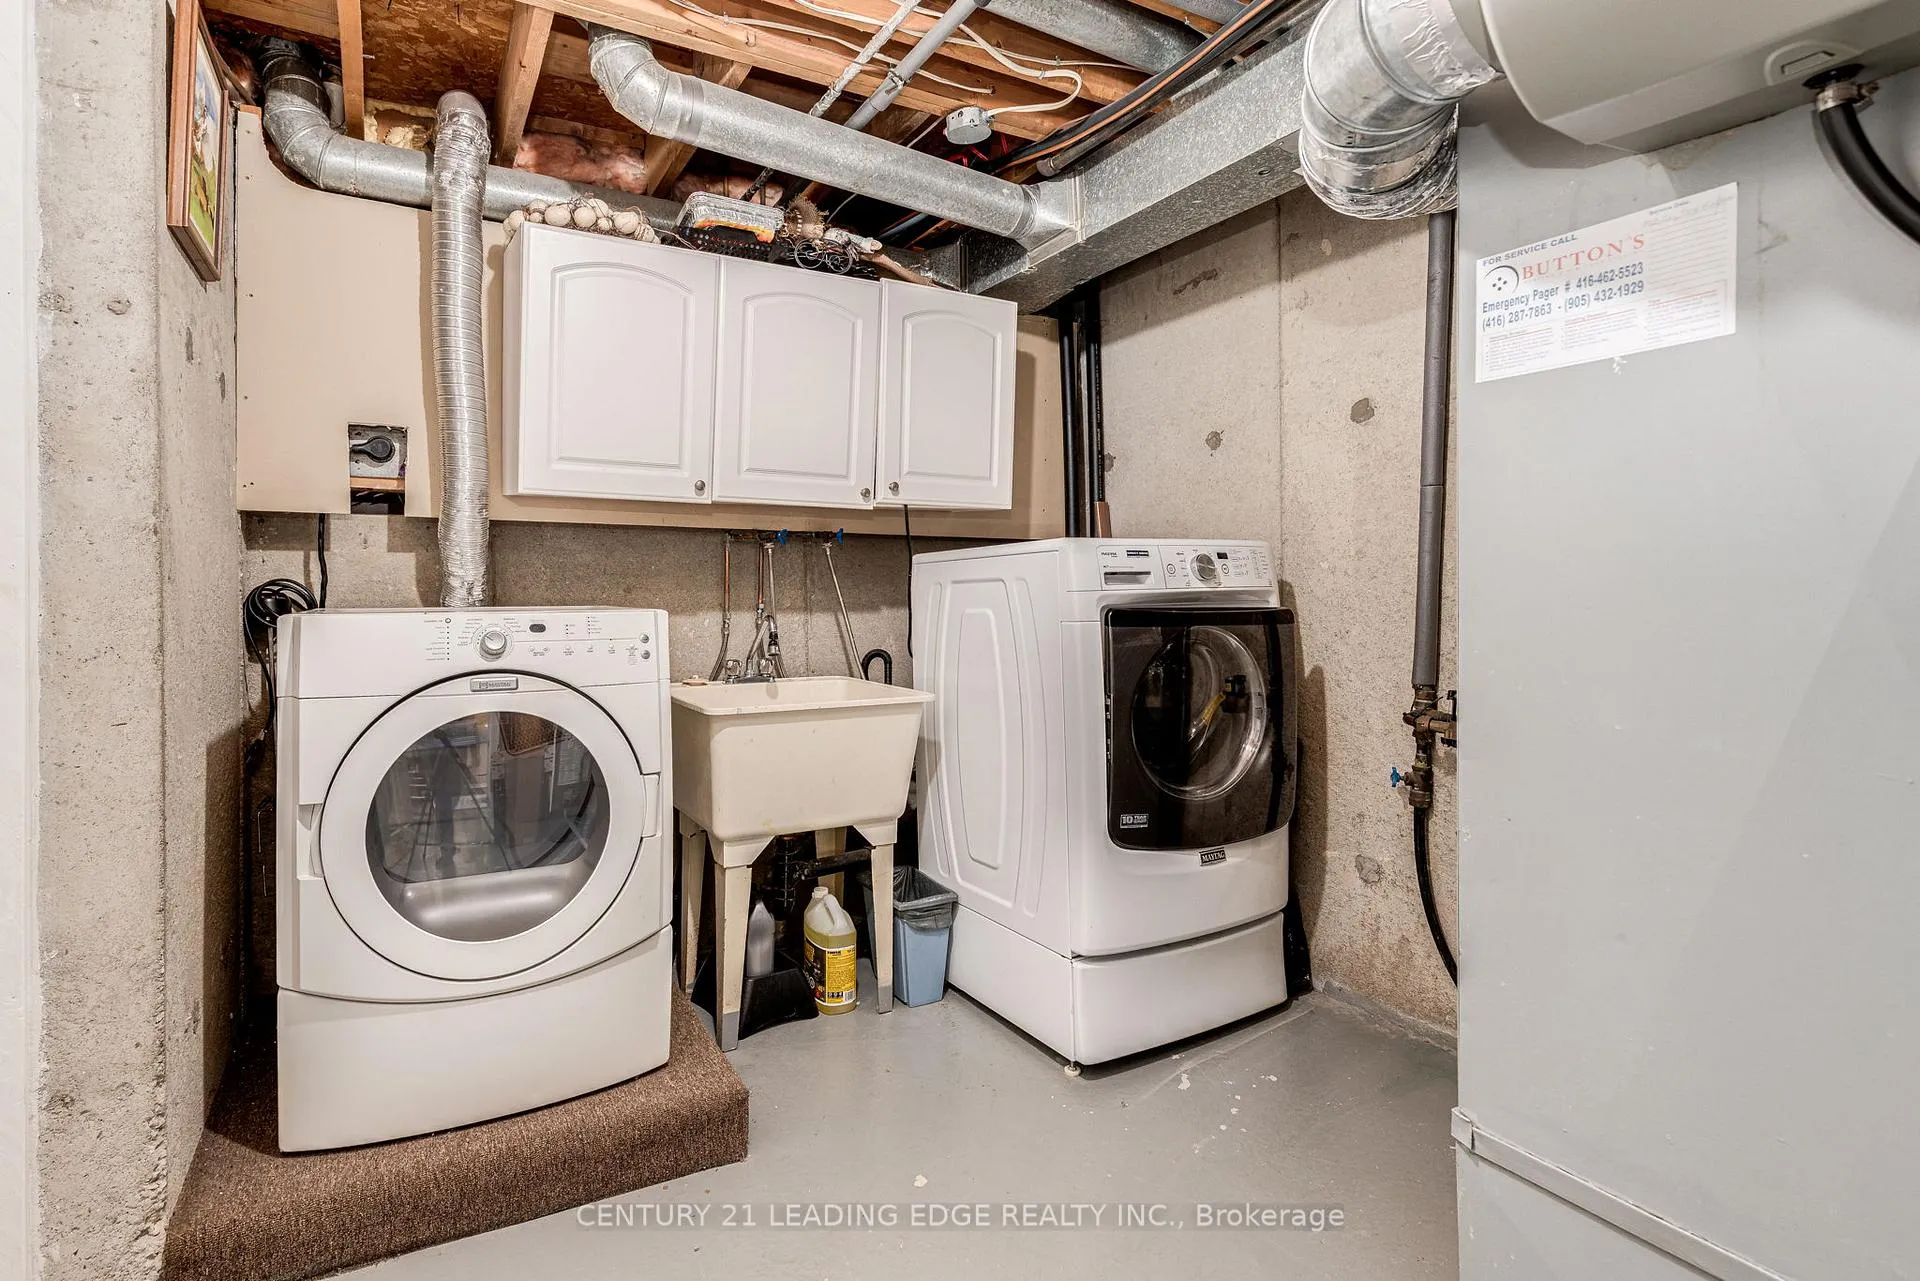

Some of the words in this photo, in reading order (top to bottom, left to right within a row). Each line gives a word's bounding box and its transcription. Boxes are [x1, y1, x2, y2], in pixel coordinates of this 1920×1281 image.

[1482, 256, 1502, 267] FOR
[1504, 242, 1548, 261] SERVICE
[1550, 234, 1577, 248] CALL
[1522, 234, 1645, 280] BUTTON'S
[1482, 293, 1531, 314] Emergency
[1532, 286, 1560, 301] Pager
[1576, 261, 1644, 290] 416-462-5523
[1482, 314, 1506, 333] (416)
[1508, 302, 1553, 324] 287-7863
[1564, 292, 1591, 313] (905)
[1593, 280, 1645, 302] 432-1929
[1201, 850, 1225, 863] MAYTAG
